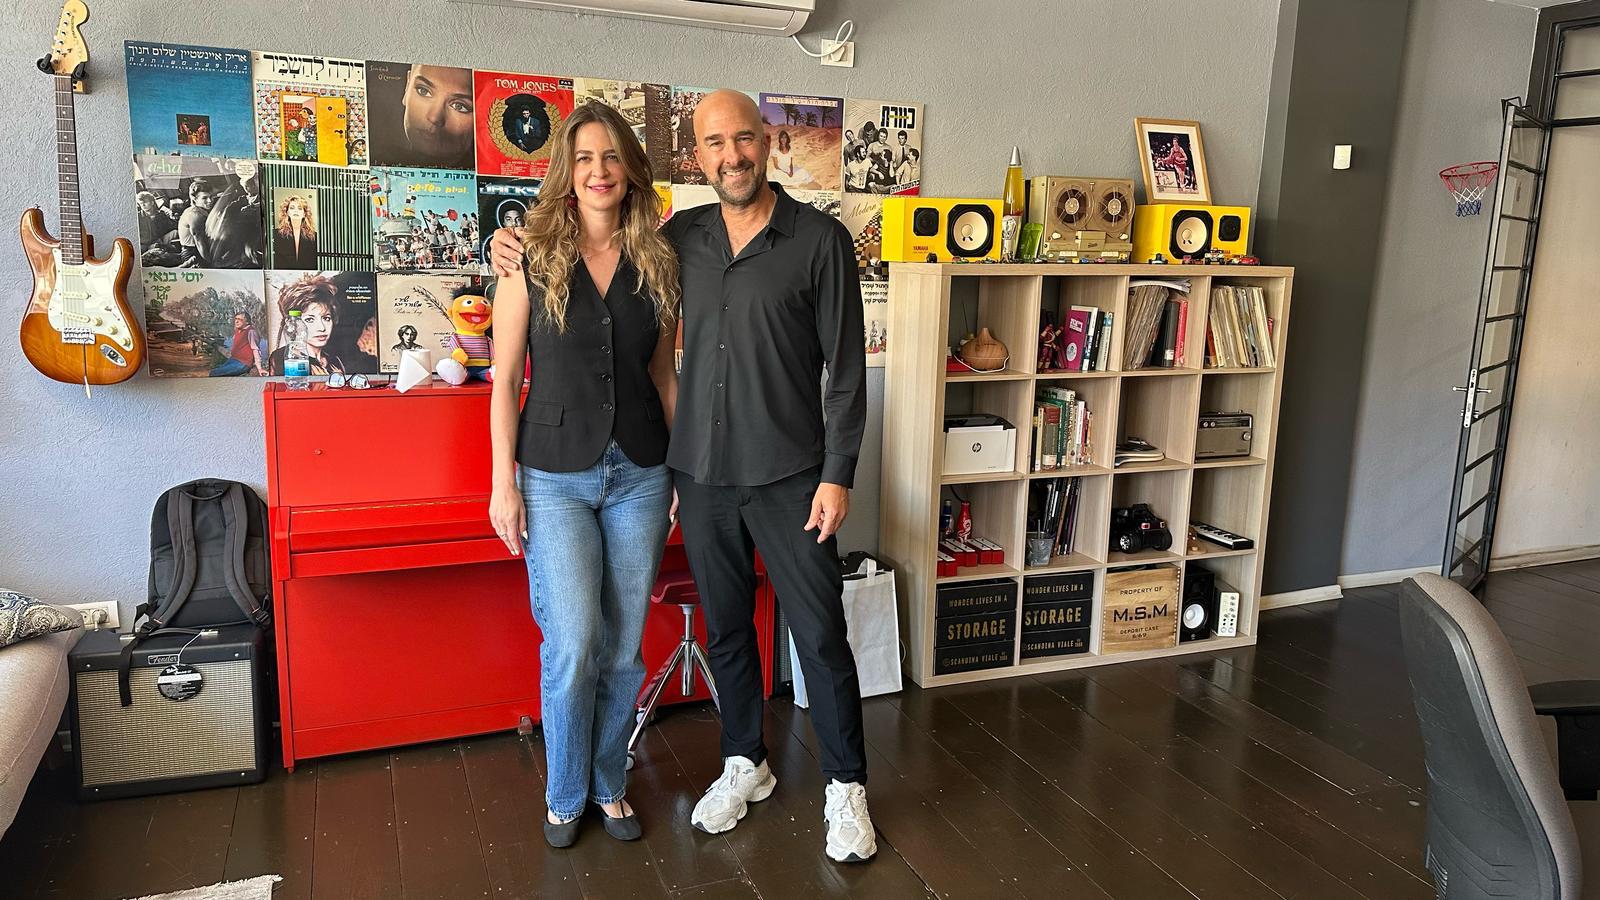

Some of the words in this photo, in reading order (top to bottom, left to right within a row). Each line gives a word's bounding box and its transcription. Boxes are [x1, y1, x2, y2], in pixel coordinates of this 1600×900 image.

[128, 45, 150, 56] חנוך
[152, 44, 177, 56] שלום
[180, 49, 222, 60] איינשטיין
[225, 53, 247, 63] אריק
[494, 78, 518, 89] TOM
[521, 80, 557, 93] JONES
[880, 106, 915, 129] כוורת
[147, 158, 182, 173] a-ha
[420, 170, 439, 179] חיל
[444, 172, 475, 181] להקת
[479, 182, 541, 197] JACKS
[148, 271, 178, 282] בנאי
[181, 271, 204, 282] יוסי
[1026, 586, 1050, 594] WONDER
[1052, 584, 1069, 593] LIVES
[1071, 584, 1078, 592] IN
[1120, 587, 1152, 595] PROPERTY
[948, 597, 974, 607] WONDER
[975, 596, 993, 605] LIVES
[994, 595, 1002, 603] IN
[1004, 594, 1008, 602] A
[1024, 607, 1082, 626] STORAGE
[1113, 603, 1168, 623] M.S.M
[947, 618, 1006, 640] STORAGE
[1120, 627, 1144, 635] DEPOSIT
[150, 655, 178, 664] Fender
